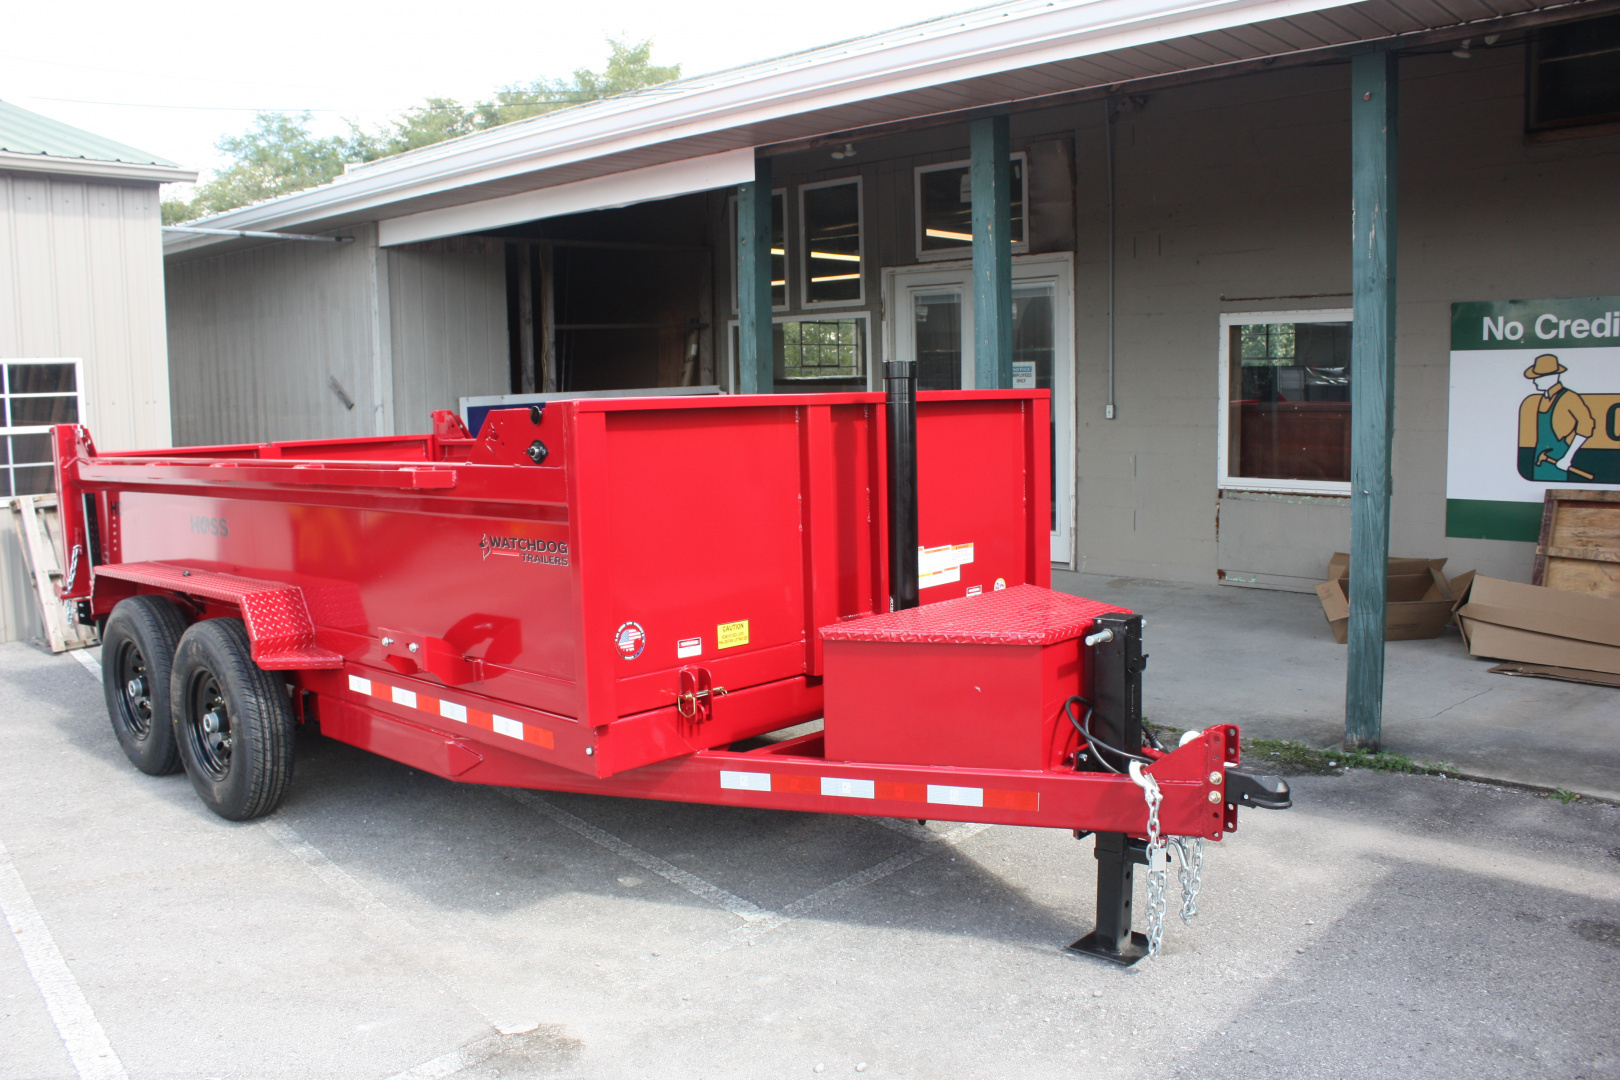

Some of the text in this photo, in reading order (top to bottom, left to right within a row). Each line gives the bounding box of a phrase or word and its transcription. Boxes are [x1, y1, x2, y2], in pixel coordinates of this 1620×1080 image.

[1482, 311, 1620, 341] No Credi
[110, 501, 124, 516] HD
[190, 515, 229, 537] HOSS
[489, 536, 569, 555] WATCHDOG
[522, 553, 569, 567] TRAILERS
[722, 623, 744, 632] CAUTION
